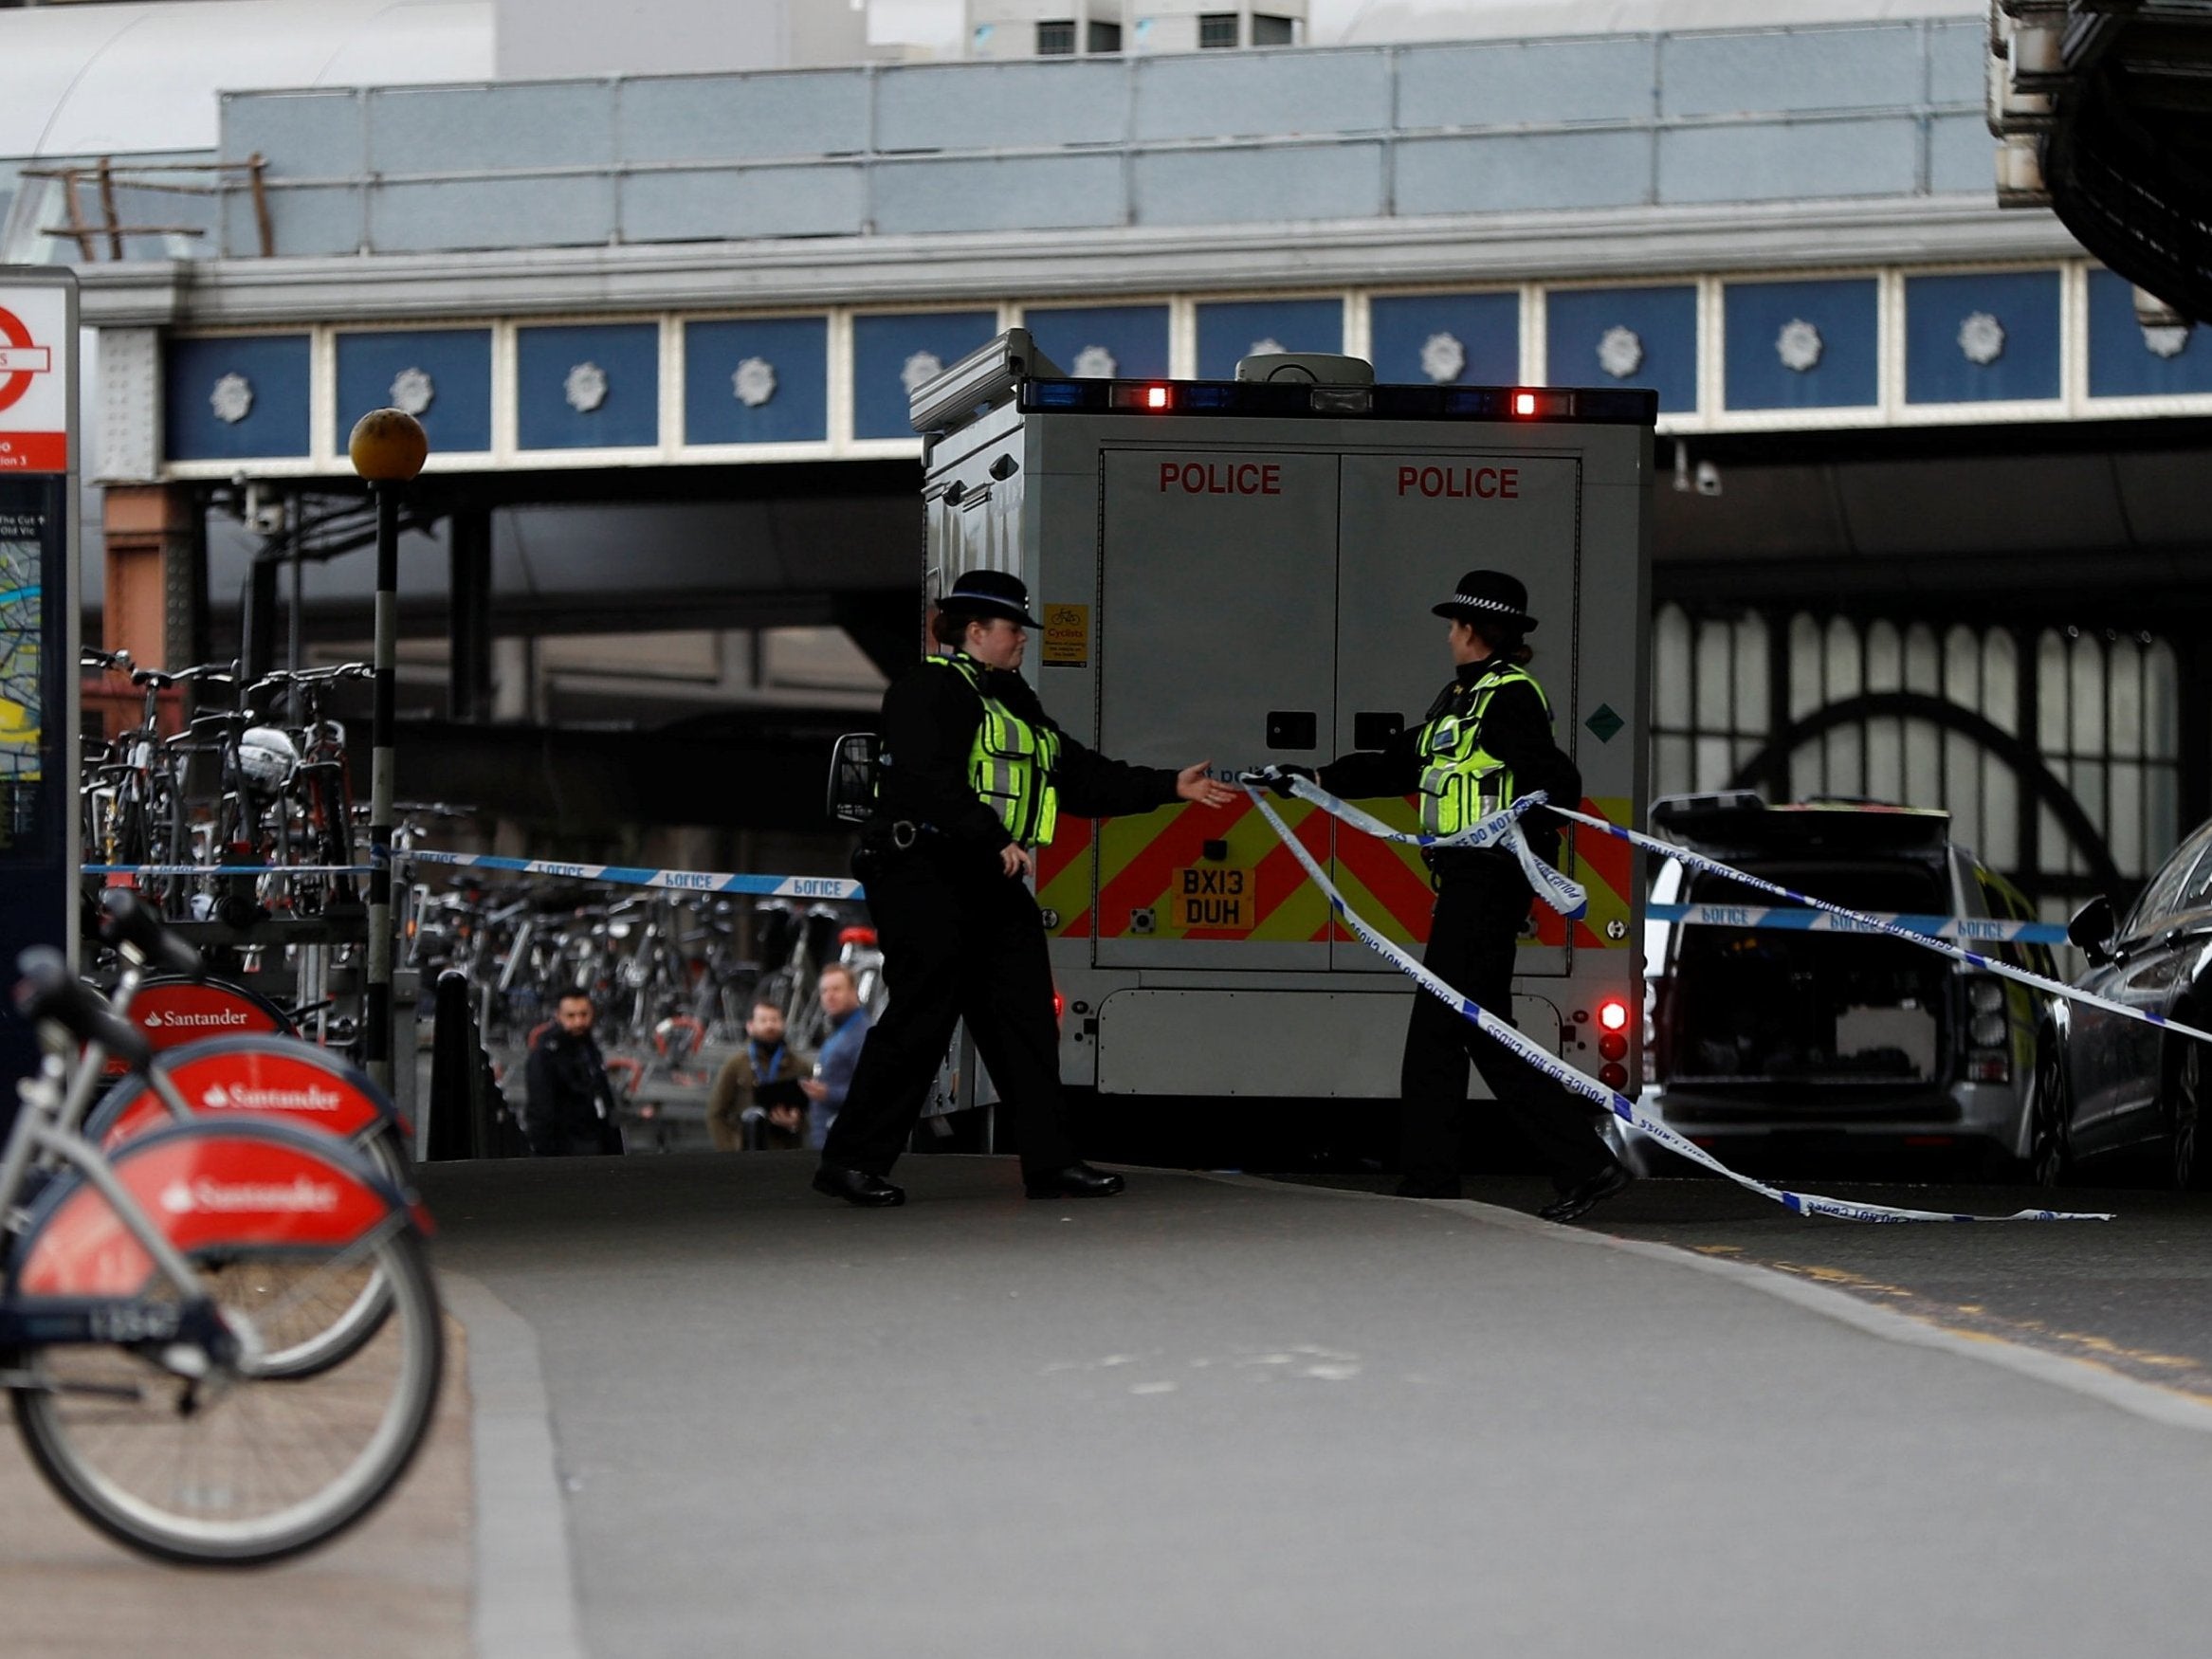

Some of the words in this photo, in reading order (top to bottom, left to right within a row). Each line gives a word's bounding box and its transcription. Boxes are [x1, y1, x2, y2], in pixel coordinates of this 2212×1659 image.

[19, 454, 27, 466] 3
[1161, 463, 1281, 495] POLICE
[1398, 466, 1519, 499] POLICE
[0, 525, 17, 536] Old
[19, 525, 35, 536] Vic
[1470, 828, 1487, 845] DO
[1488, 811, 1511, 834] NOT
[1183, 869, 1244, 895] BX13
[1186, 899, 1239, 924] DUH
[164, 1008, 247, 1027] Santander
[1547, 1065, 1565, 1081] DO
[229, 1083, 340, 1111] Santander
[1565, 1075, 1607, 1106] POLICE
